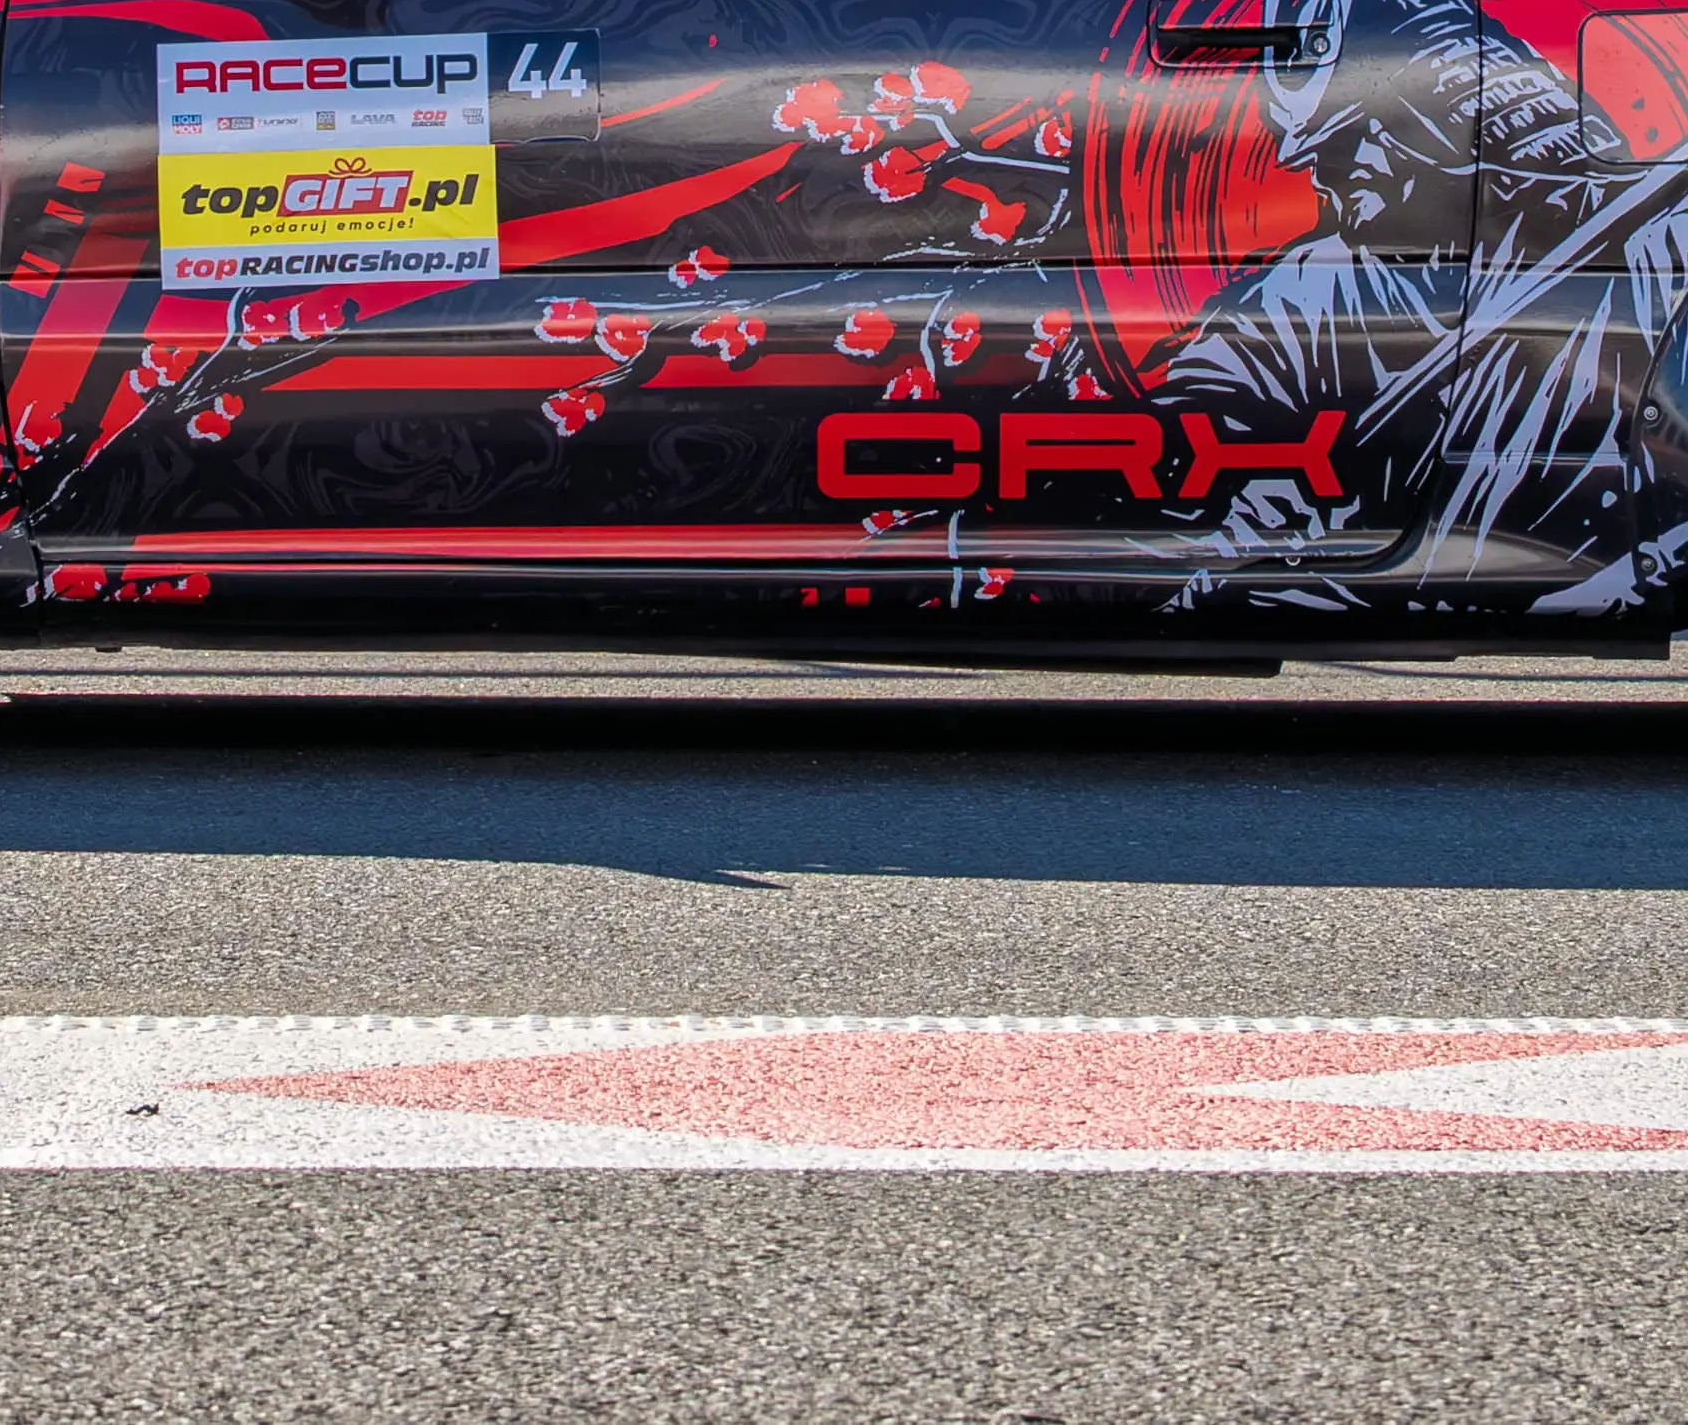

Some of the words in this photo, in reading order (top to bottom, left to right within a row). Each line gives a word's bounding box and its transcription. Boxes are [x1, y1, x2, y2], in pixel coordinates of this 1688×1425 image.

[508, 41, 587, 99] 44
[172, 115, 201, 125] LIQUI
[173, 125, 202, 134] MOLY
[181, 173, 479, 219] topGIFT.pl
[249, 220, 328, 237] podaruj
[336, 217, 415, 233] emocje!
[175, 246, 492, 281] topRACINGshop.pl
[817, 410, 1346, 500] CRX
